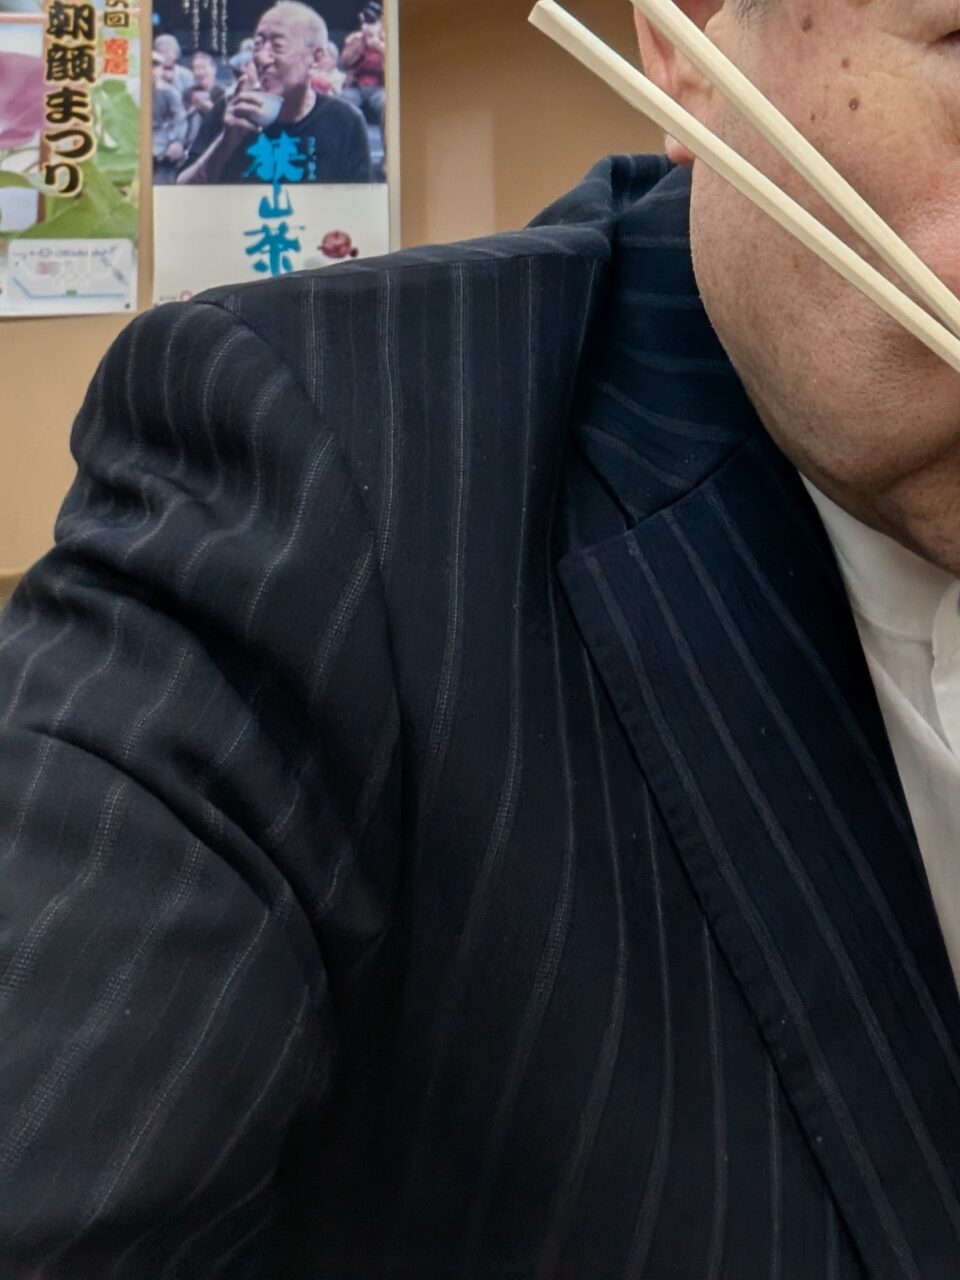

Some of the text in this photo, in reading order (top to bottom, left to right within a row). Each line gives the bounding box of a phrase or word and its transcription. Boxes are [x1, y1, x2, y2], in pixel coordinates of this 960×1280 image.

[45, 1, 96, 194] 朝顔まつり
